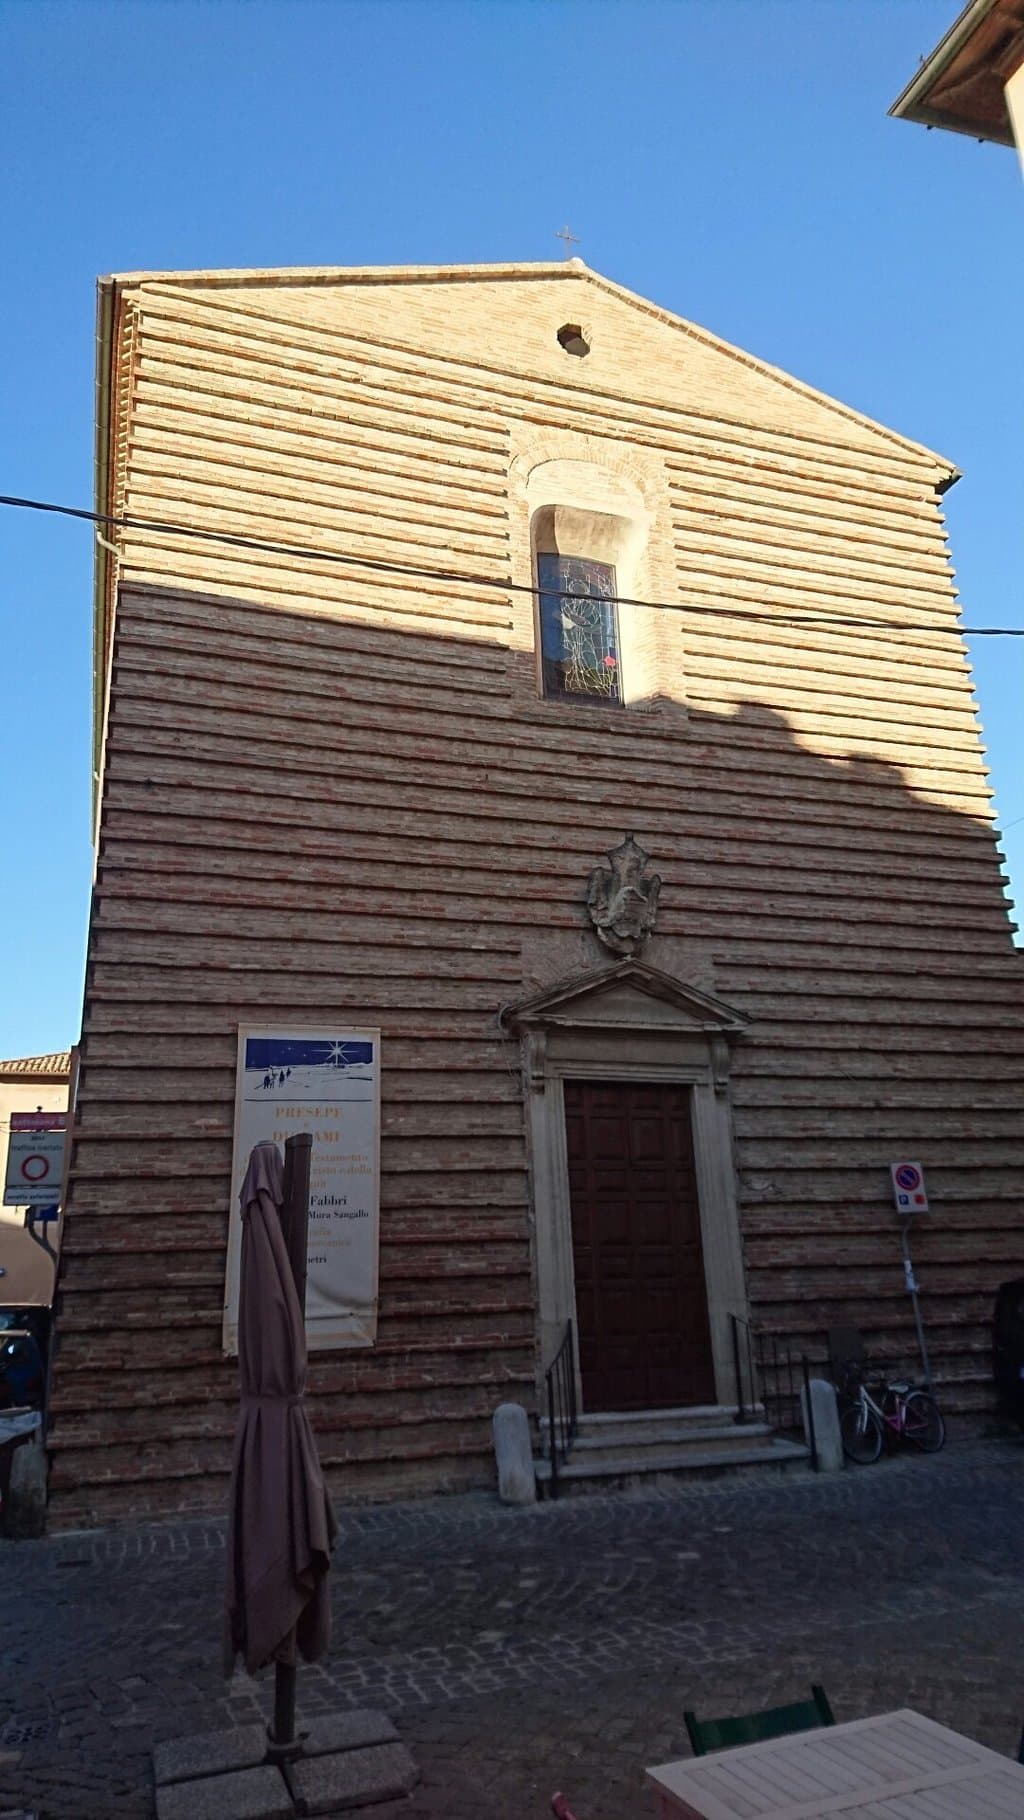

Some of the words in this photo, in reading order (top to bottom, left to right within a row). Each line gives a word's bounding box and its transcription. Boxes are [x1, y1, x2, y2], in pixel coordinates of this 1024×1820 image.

[275, 1107, 343, 1119] PRESEPE
[310, 1194, 347, 1206] Fabbri
[333, 1209, 369, 1219] Sangallo
